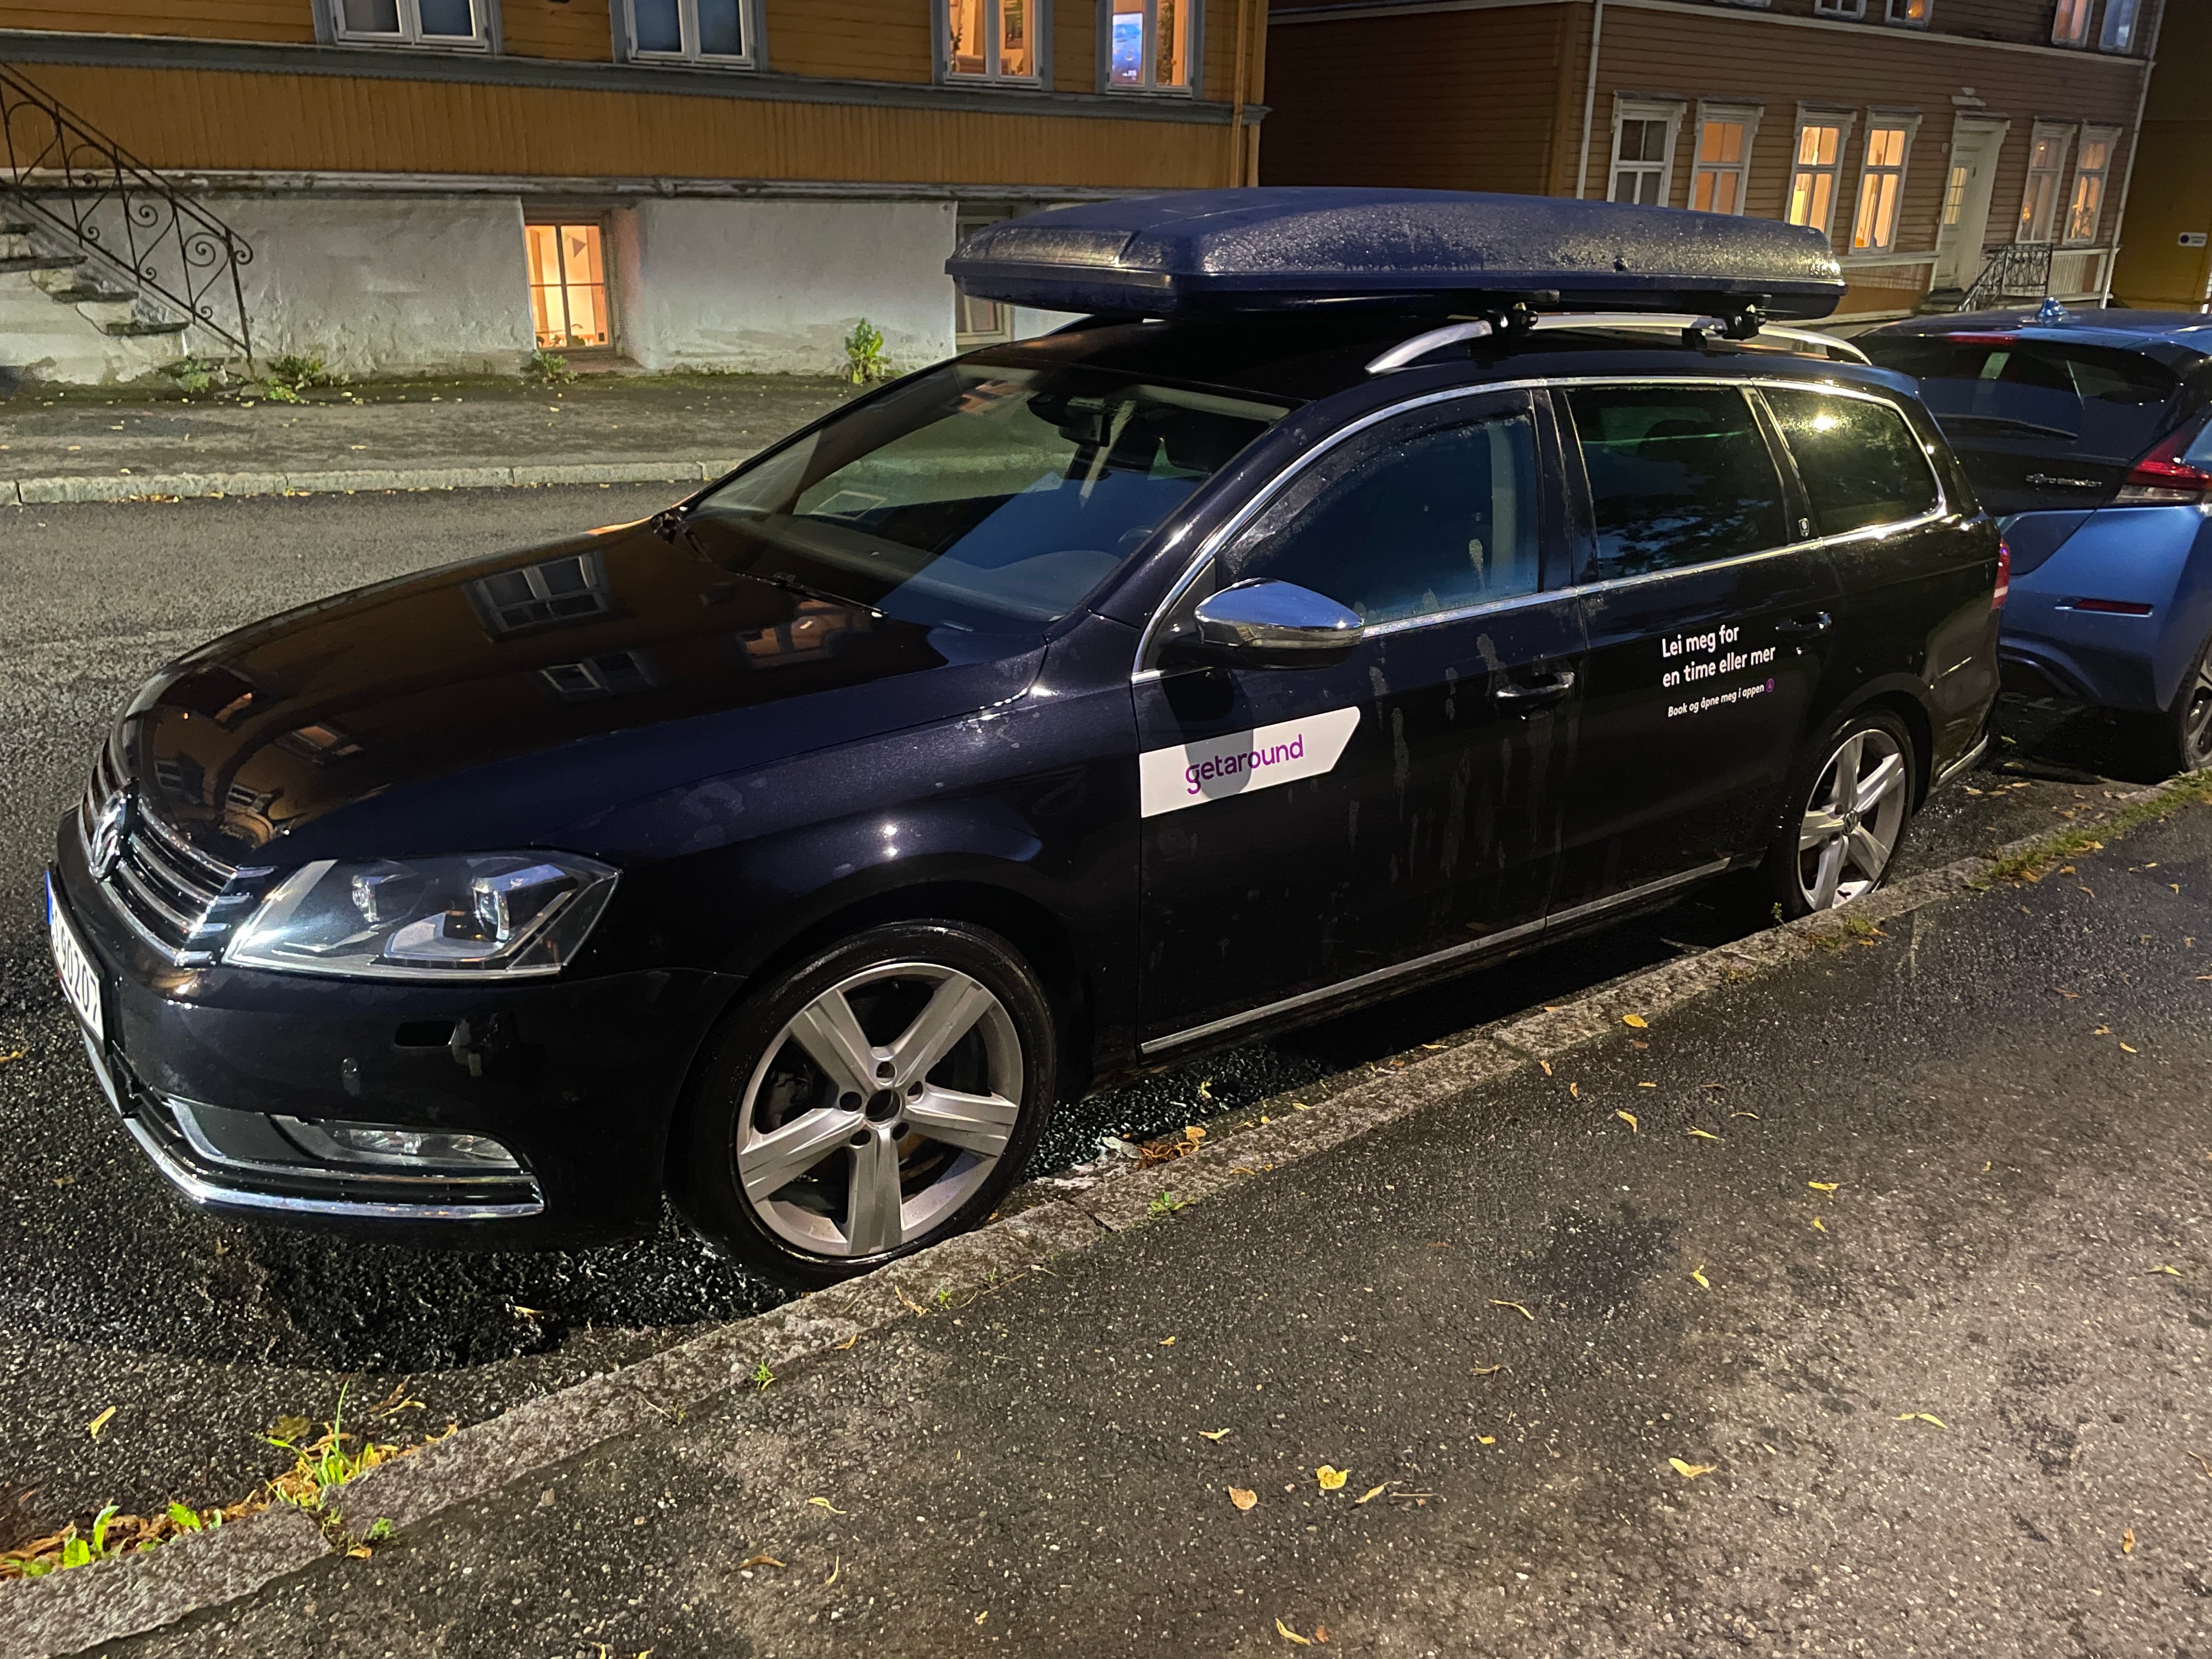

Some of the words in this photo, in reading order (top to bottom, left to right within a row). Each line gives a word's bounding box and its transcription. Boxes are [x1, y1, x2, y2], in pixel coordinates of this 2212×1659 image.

[1662, 634, 1682, 658] Lei
[1686, 631, 1716, 653] meg
[1719, 624, 1739, 644] for
[1663, 670, 1680, 687] en
[1683, 661, 1716, 682] time
[1719, 652, 1747, 674] eller
[1751, 646, 1776, 666] mer
[1668, 703, 1688, 717] Book
[1689, 700, 1699, 713] og
[1701, 697, 1719, 710] åpne
[1721, 690, 1737, 703] meg
[1738, 687, 1741, 698] i
[1742, 684, 1764, 699] appen
[1186, 733, 1304, 794] getaround
